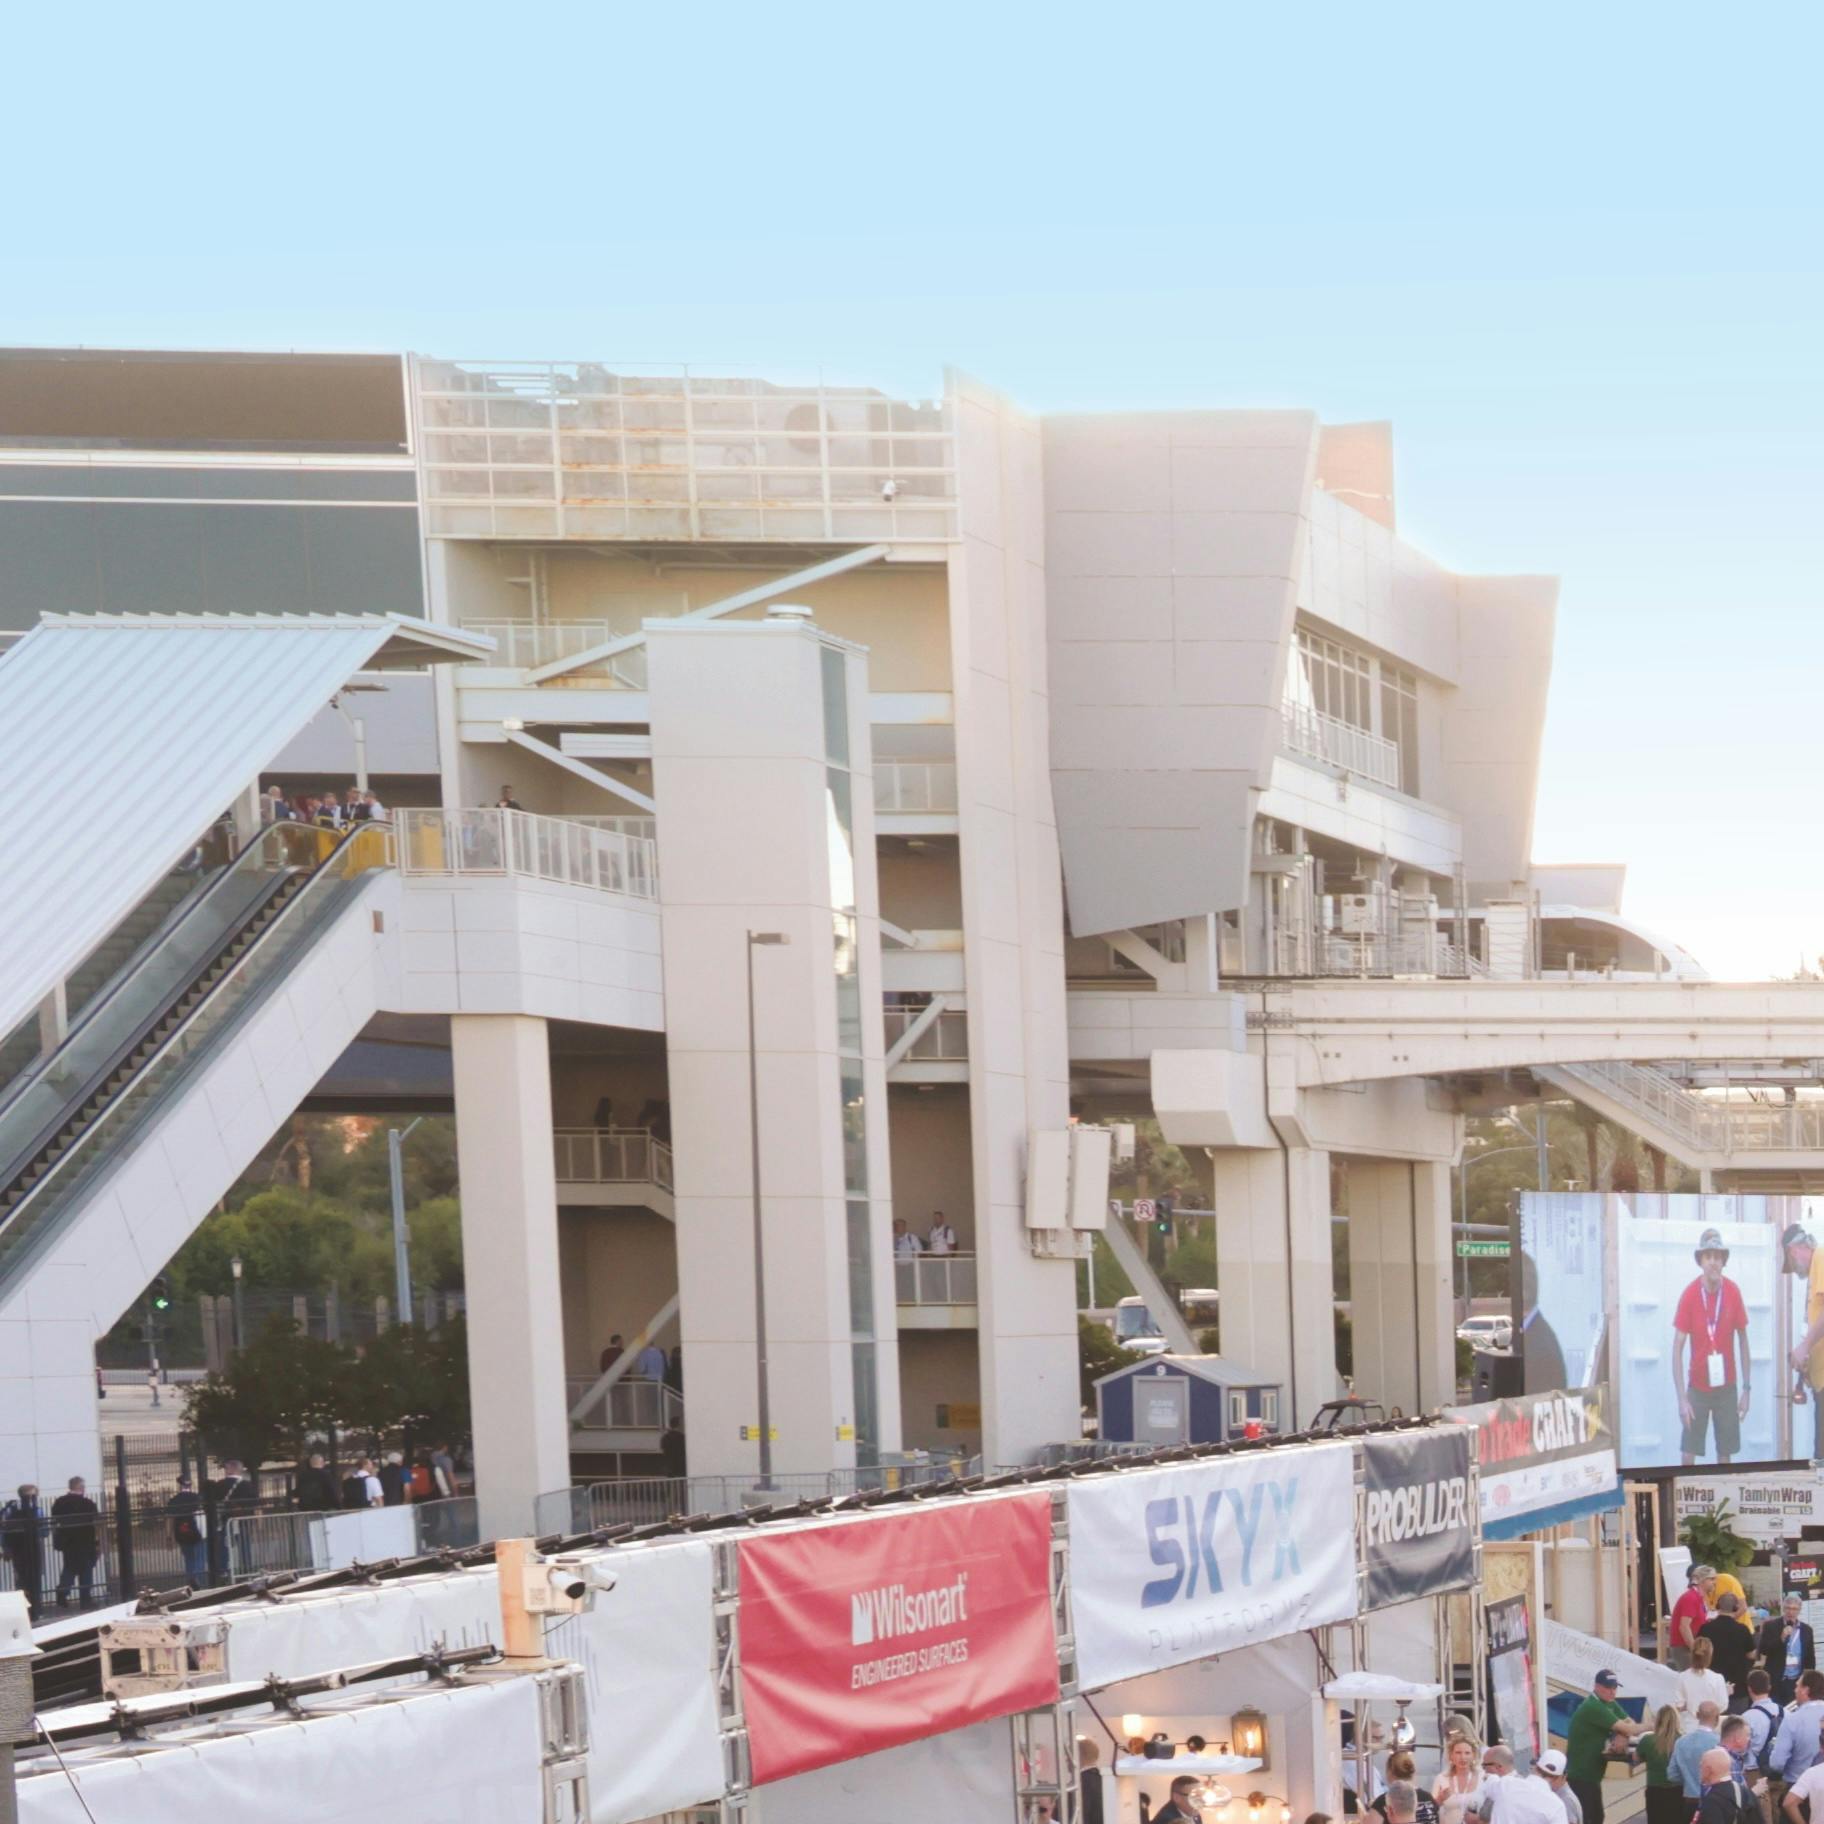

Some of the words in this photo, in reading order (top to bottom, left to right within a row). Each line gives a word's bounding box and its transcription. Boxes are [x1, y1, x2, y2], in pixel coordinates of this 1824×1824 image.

[1367, 1476, 1467, 1547] PROBUILDER
[1739, 1486, 1813, 1505] TamlynWrap
[1141, 1477, 1302, 1609] SKYX
[874, 1573, 968, 1640] Wilsonart
[852, 1651, 917, 1689] ENGINEERED
[918, 1638, 968, 1672] SURFACES
